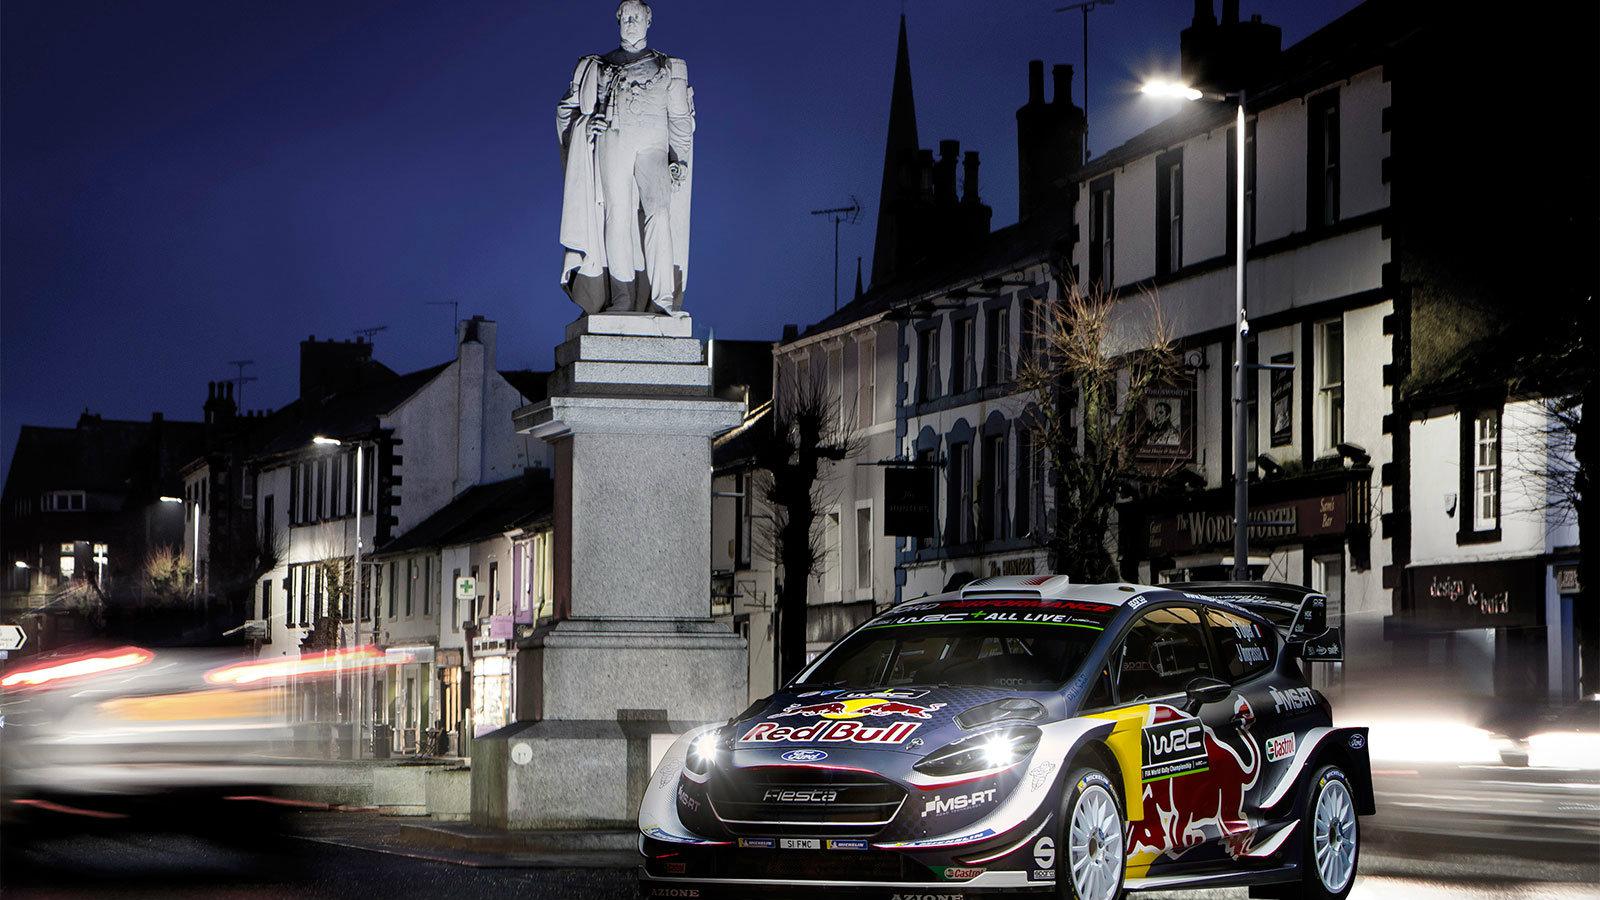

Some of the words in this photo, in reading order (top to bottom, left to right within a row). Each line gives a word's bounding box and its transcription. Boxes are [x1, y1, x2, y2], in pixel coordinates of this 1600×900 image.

[1188, 506, 1297, 545] WORDWORTH
[1430, 576, 1464, 601] design
[1467, 583, 1478, 605] &
[984, 612, 1019, 622] ALL
[1023, 612, 1067, 623] LIVE
[742, 722, 824, 742] Red
[820, 721, 921, 743] Bull
[1152, 725, 1201, 756] WRC
[1273, 733, 1295, 758] Castrol
[763, 789, 837, 801] Fiesta
[797, 840, 812, 849] FMC
